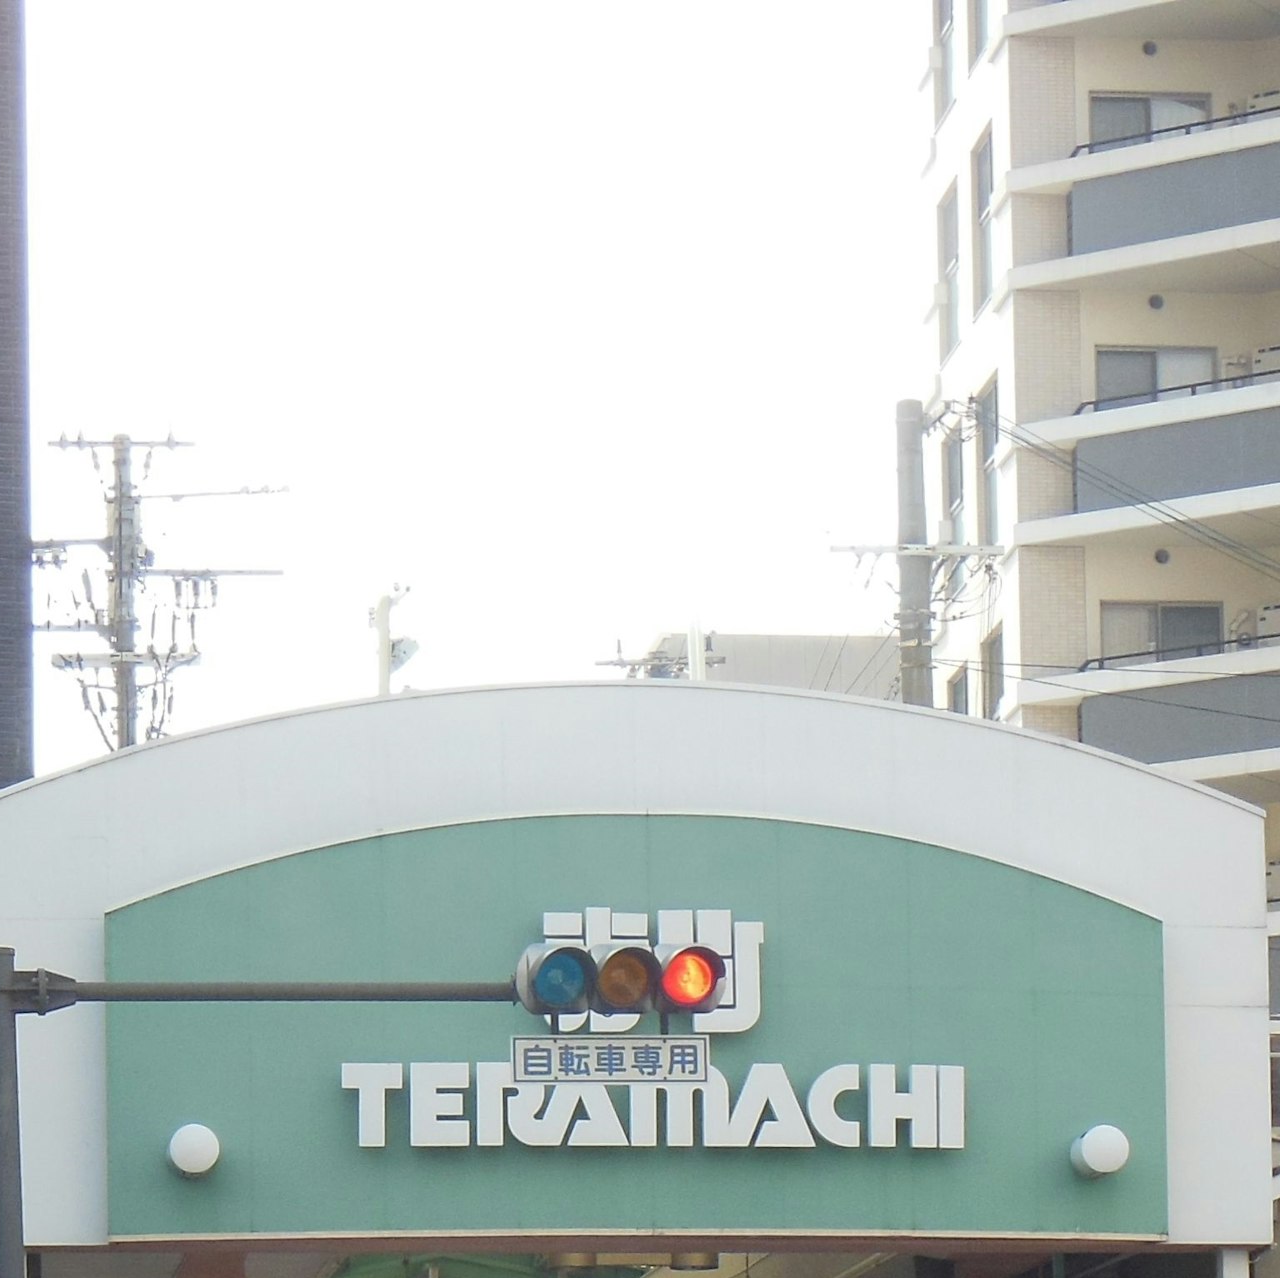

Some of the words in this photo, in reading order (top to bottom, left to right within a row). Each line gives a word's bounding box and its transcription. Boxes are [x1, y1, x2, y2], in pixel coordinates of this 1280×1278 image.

[521, 1043, 701, 1077] 自転車専用
[340, 1061, 966, 1149] TERAMACHI
